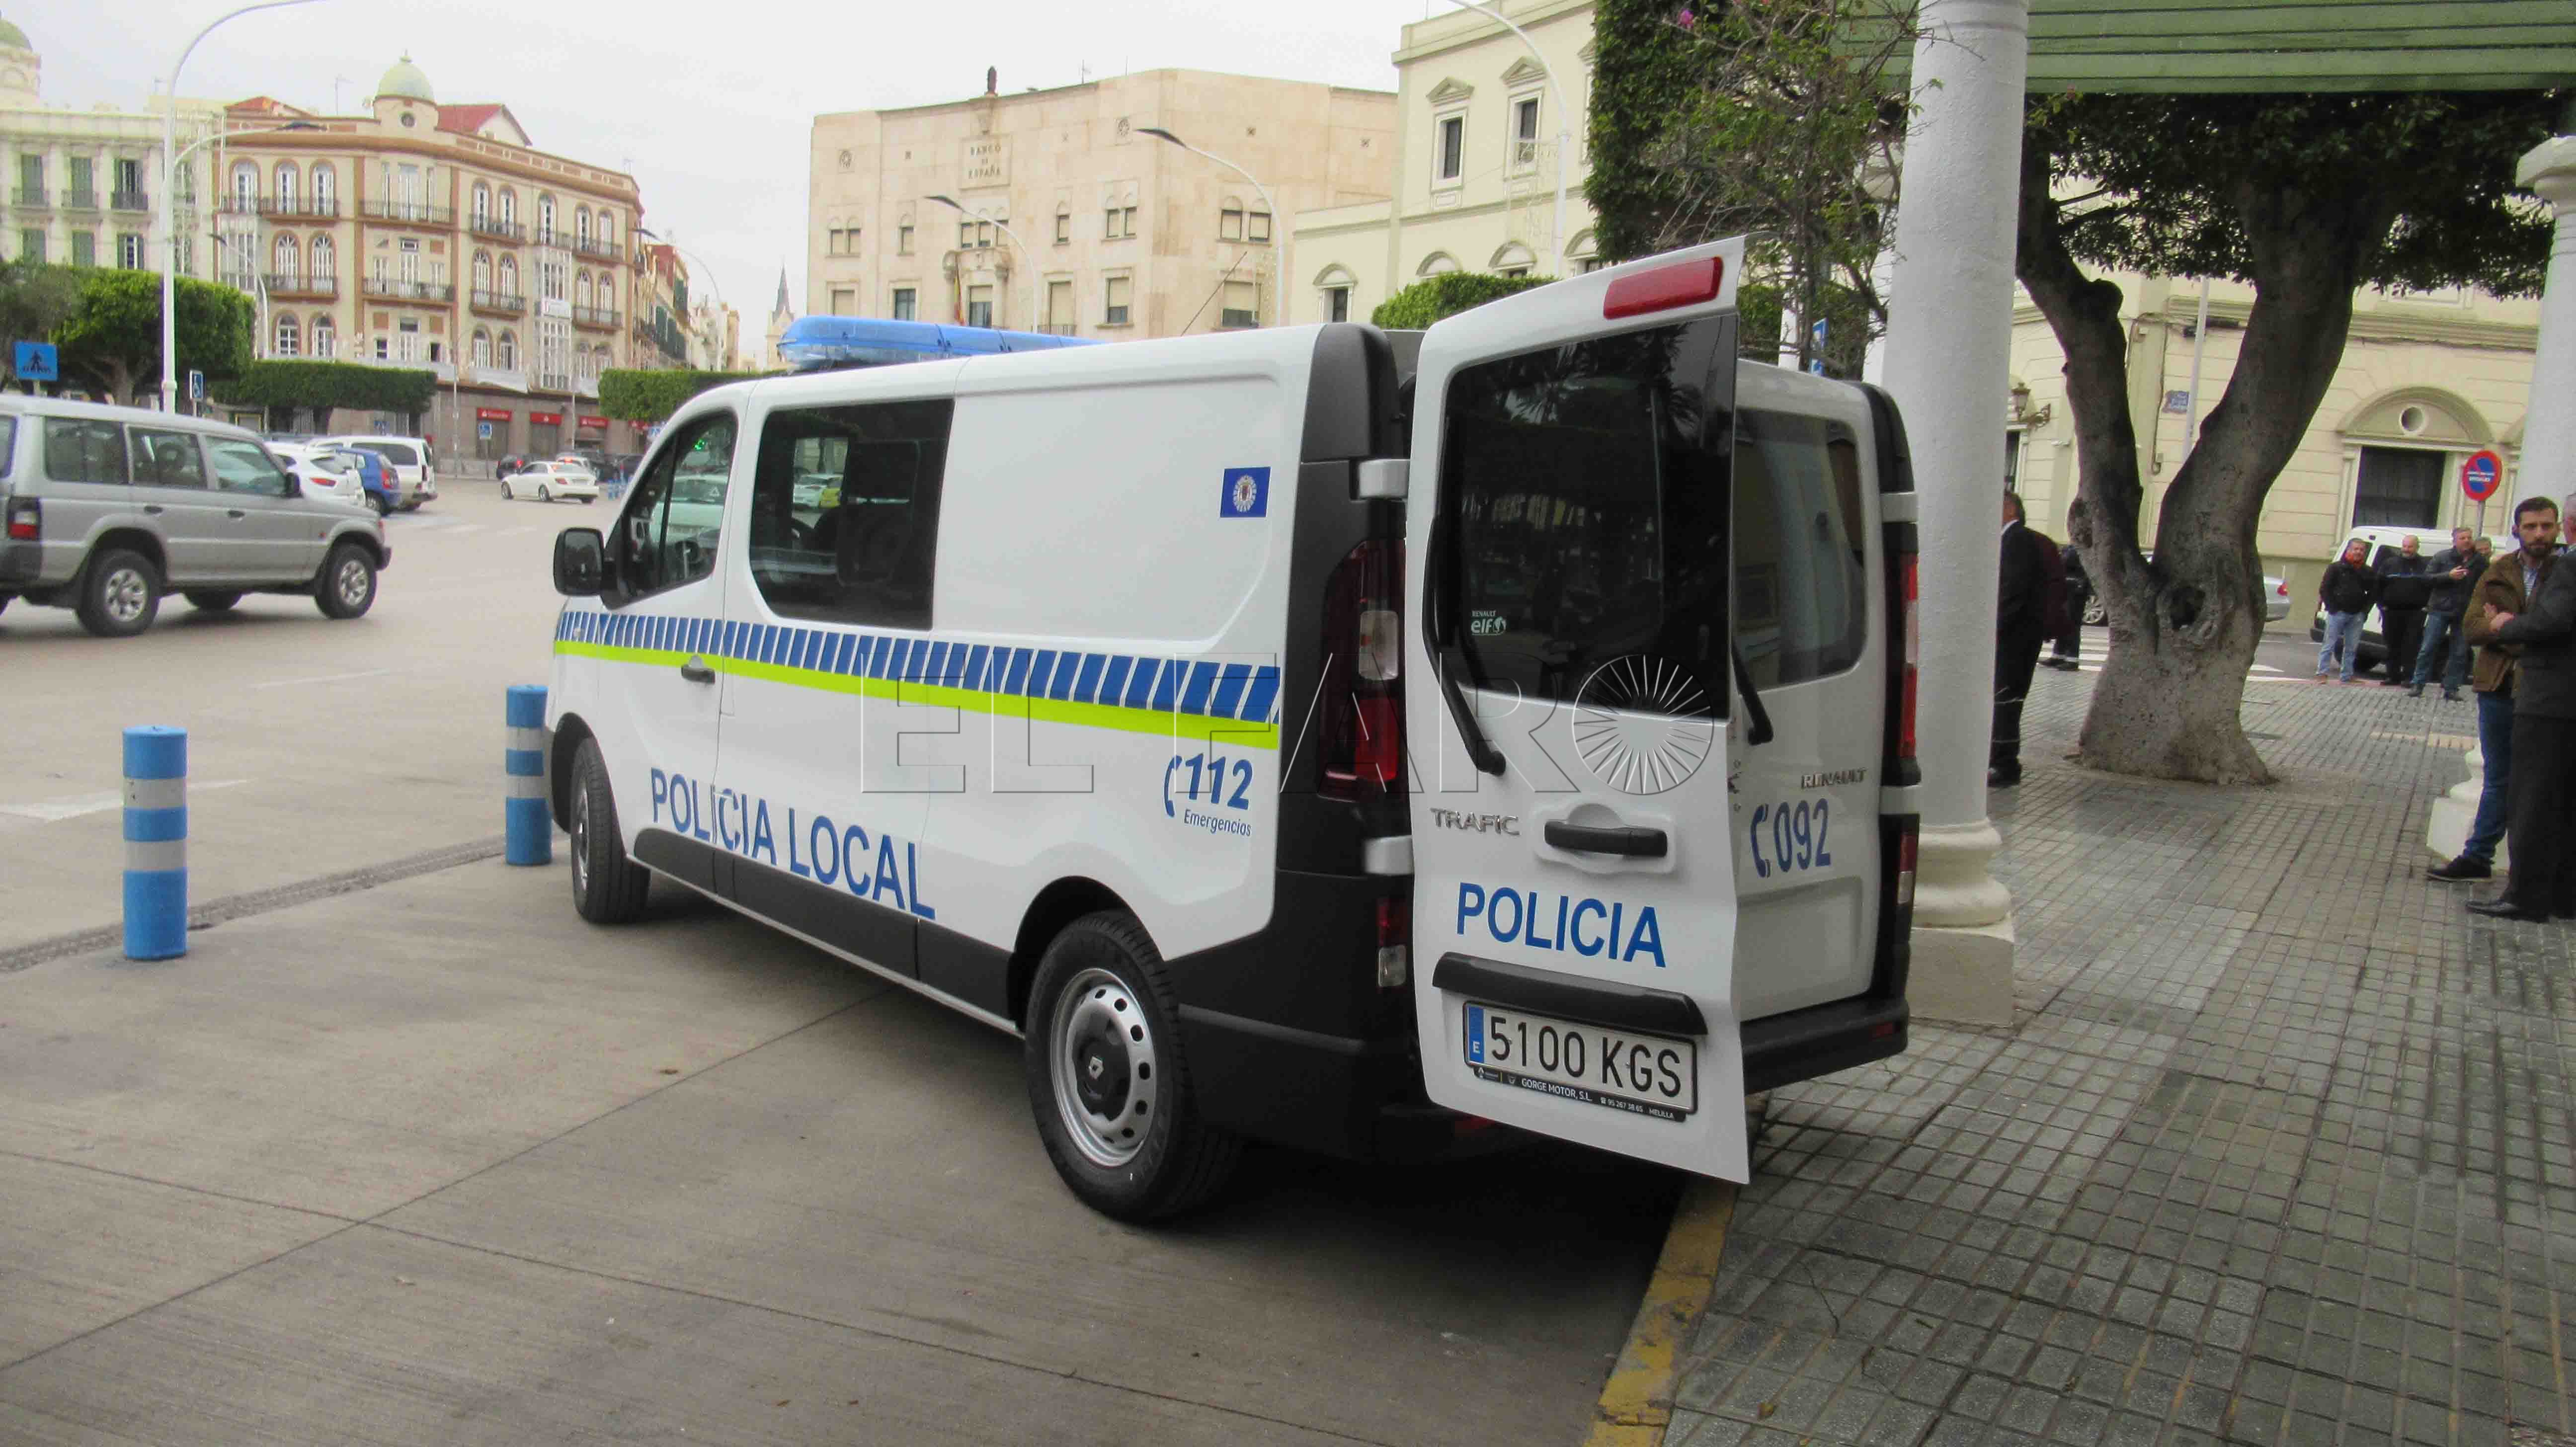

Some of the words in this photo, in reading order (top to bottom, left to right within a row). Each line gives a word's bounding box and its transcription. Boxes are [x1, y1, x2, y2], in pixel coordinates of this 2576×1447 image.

[1471, 618, 1493, 634] elf
[1185, 752, 1253, 810] 112
[1800, 767, 1868, 790] RENAULT
[1184, 808, 1252, 837] Emergencias
[1430, 807, 1521, 836] TRAFIC
[1772, 798, 1831, 873] 092
[650, 767, 777, 866] POLICIA
[788, 807, 936, 920] LOCAL
[1456, 882, 1666, 968] POLICIA
[1472, 1041, 1480, 1054] E
[1491, 1016, 1585, 1078] 5100
[1601, 1037, 1681, 1098] KGS
[1522, 1078, 1547, 1092] GORGE
